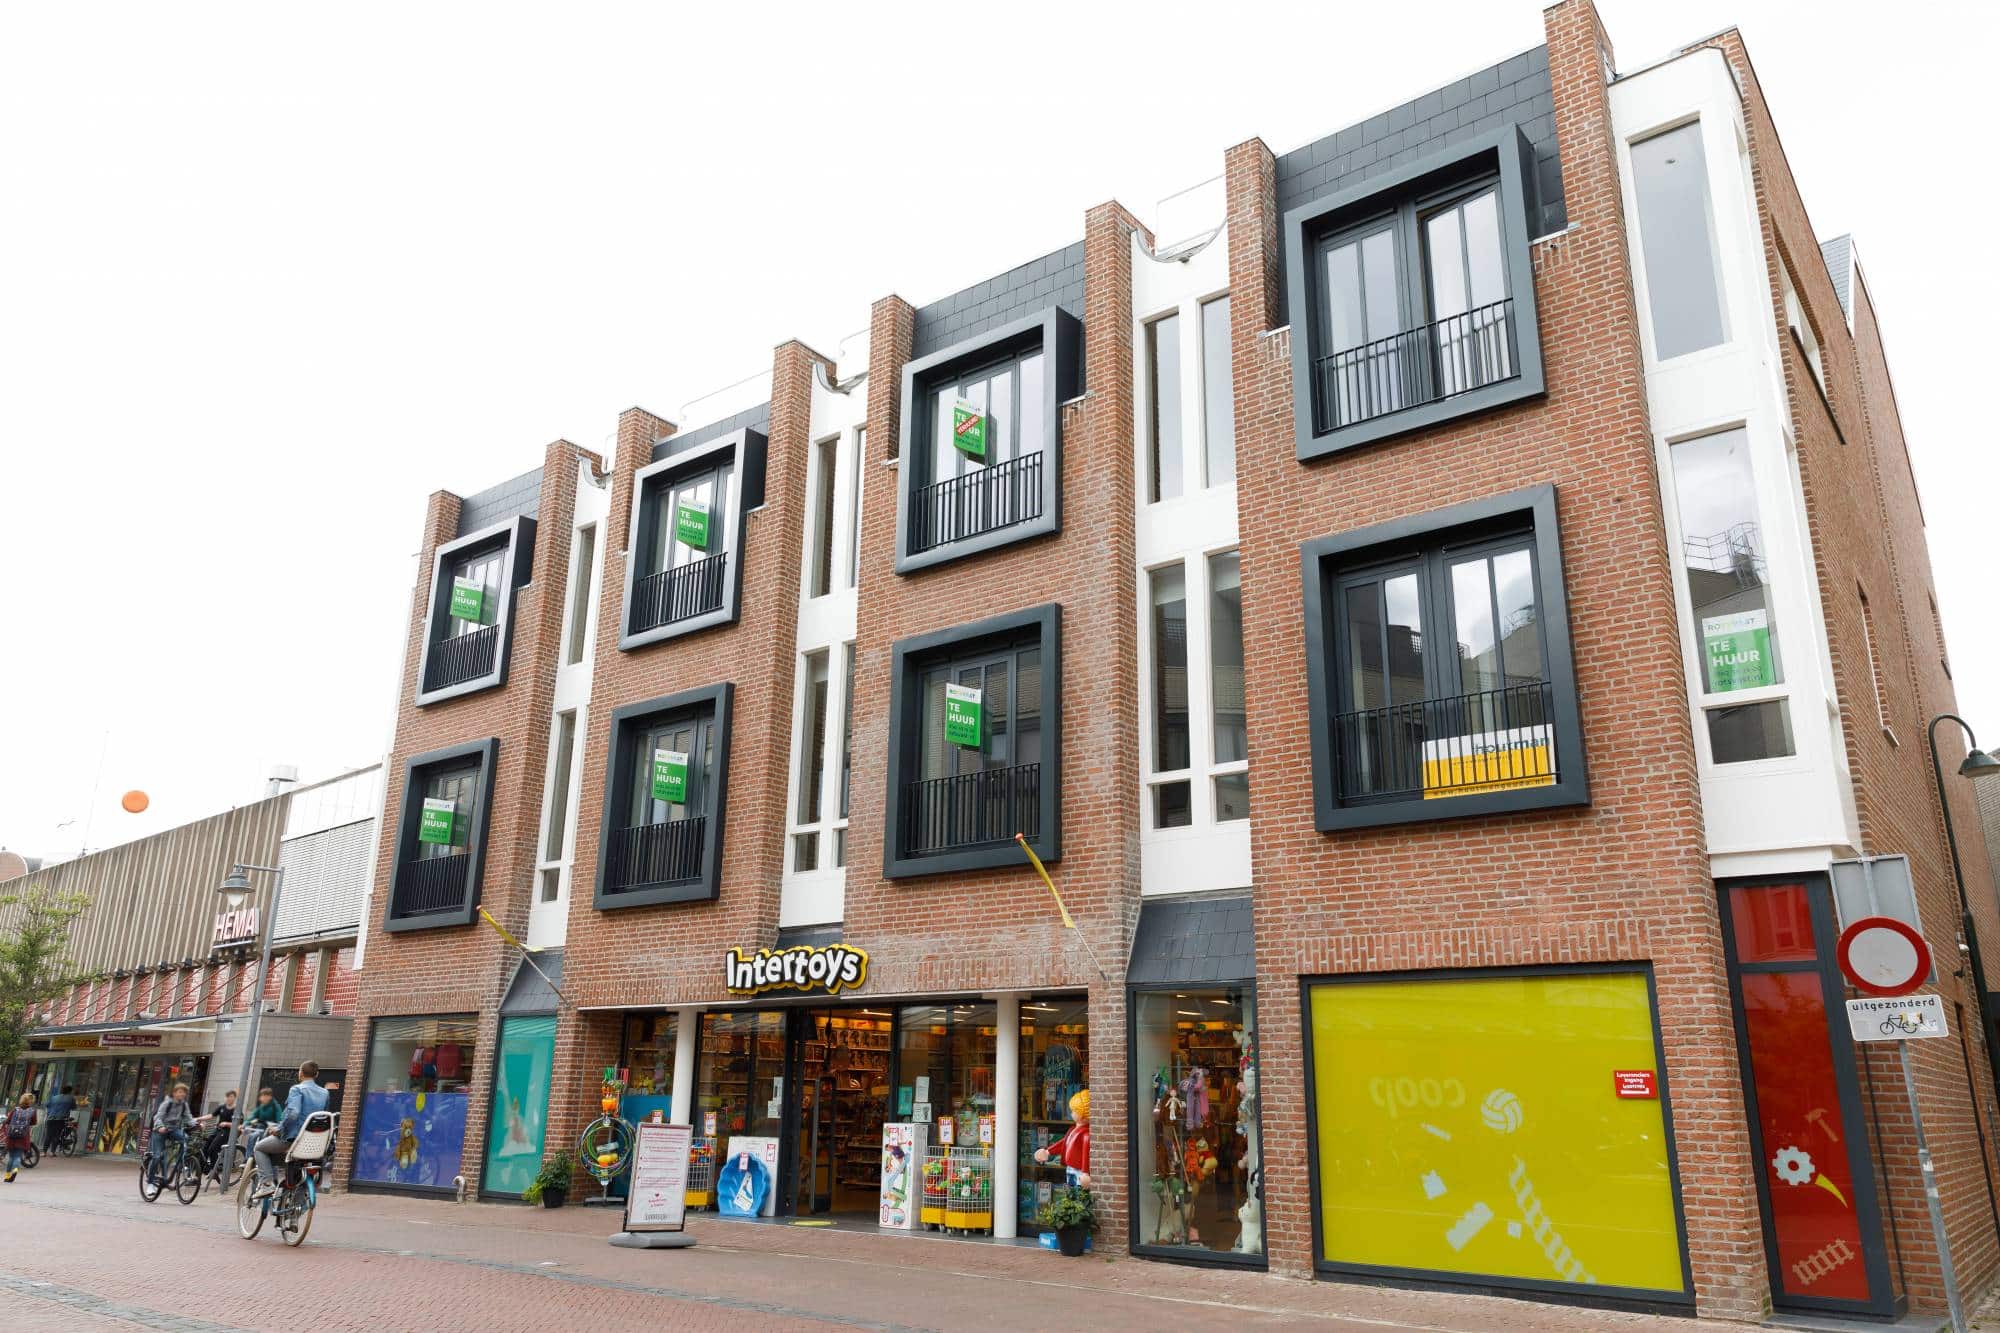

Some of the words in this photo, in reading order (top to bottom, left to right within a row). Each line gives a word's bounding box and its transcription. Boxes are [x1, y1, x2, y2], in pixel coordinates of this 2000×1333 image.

[680, 510, 692, 519] TE
[680, 518, 704, 530] HUUR
[455, 588, 465, 597] TE
[455, 596, 477, 606] HUUR
[1709, 639, 1731, 654] TE
[1712, 649, 1761, 668] HUUR
[949, 702, 960, 712] TE
[949, 712, 975, 726] HUUR
[656, 764, 668, 774] TE
[656, 774, 682, 785] HUUR
[425, 812, 436, 820] TE
[424, 819, 448, 829] HUUR
[215, 907, 256, 941] HEMA
[726, 946, 862, 990] Intertoys
[1852, 998, 1935, 1011] uitgezonderd
